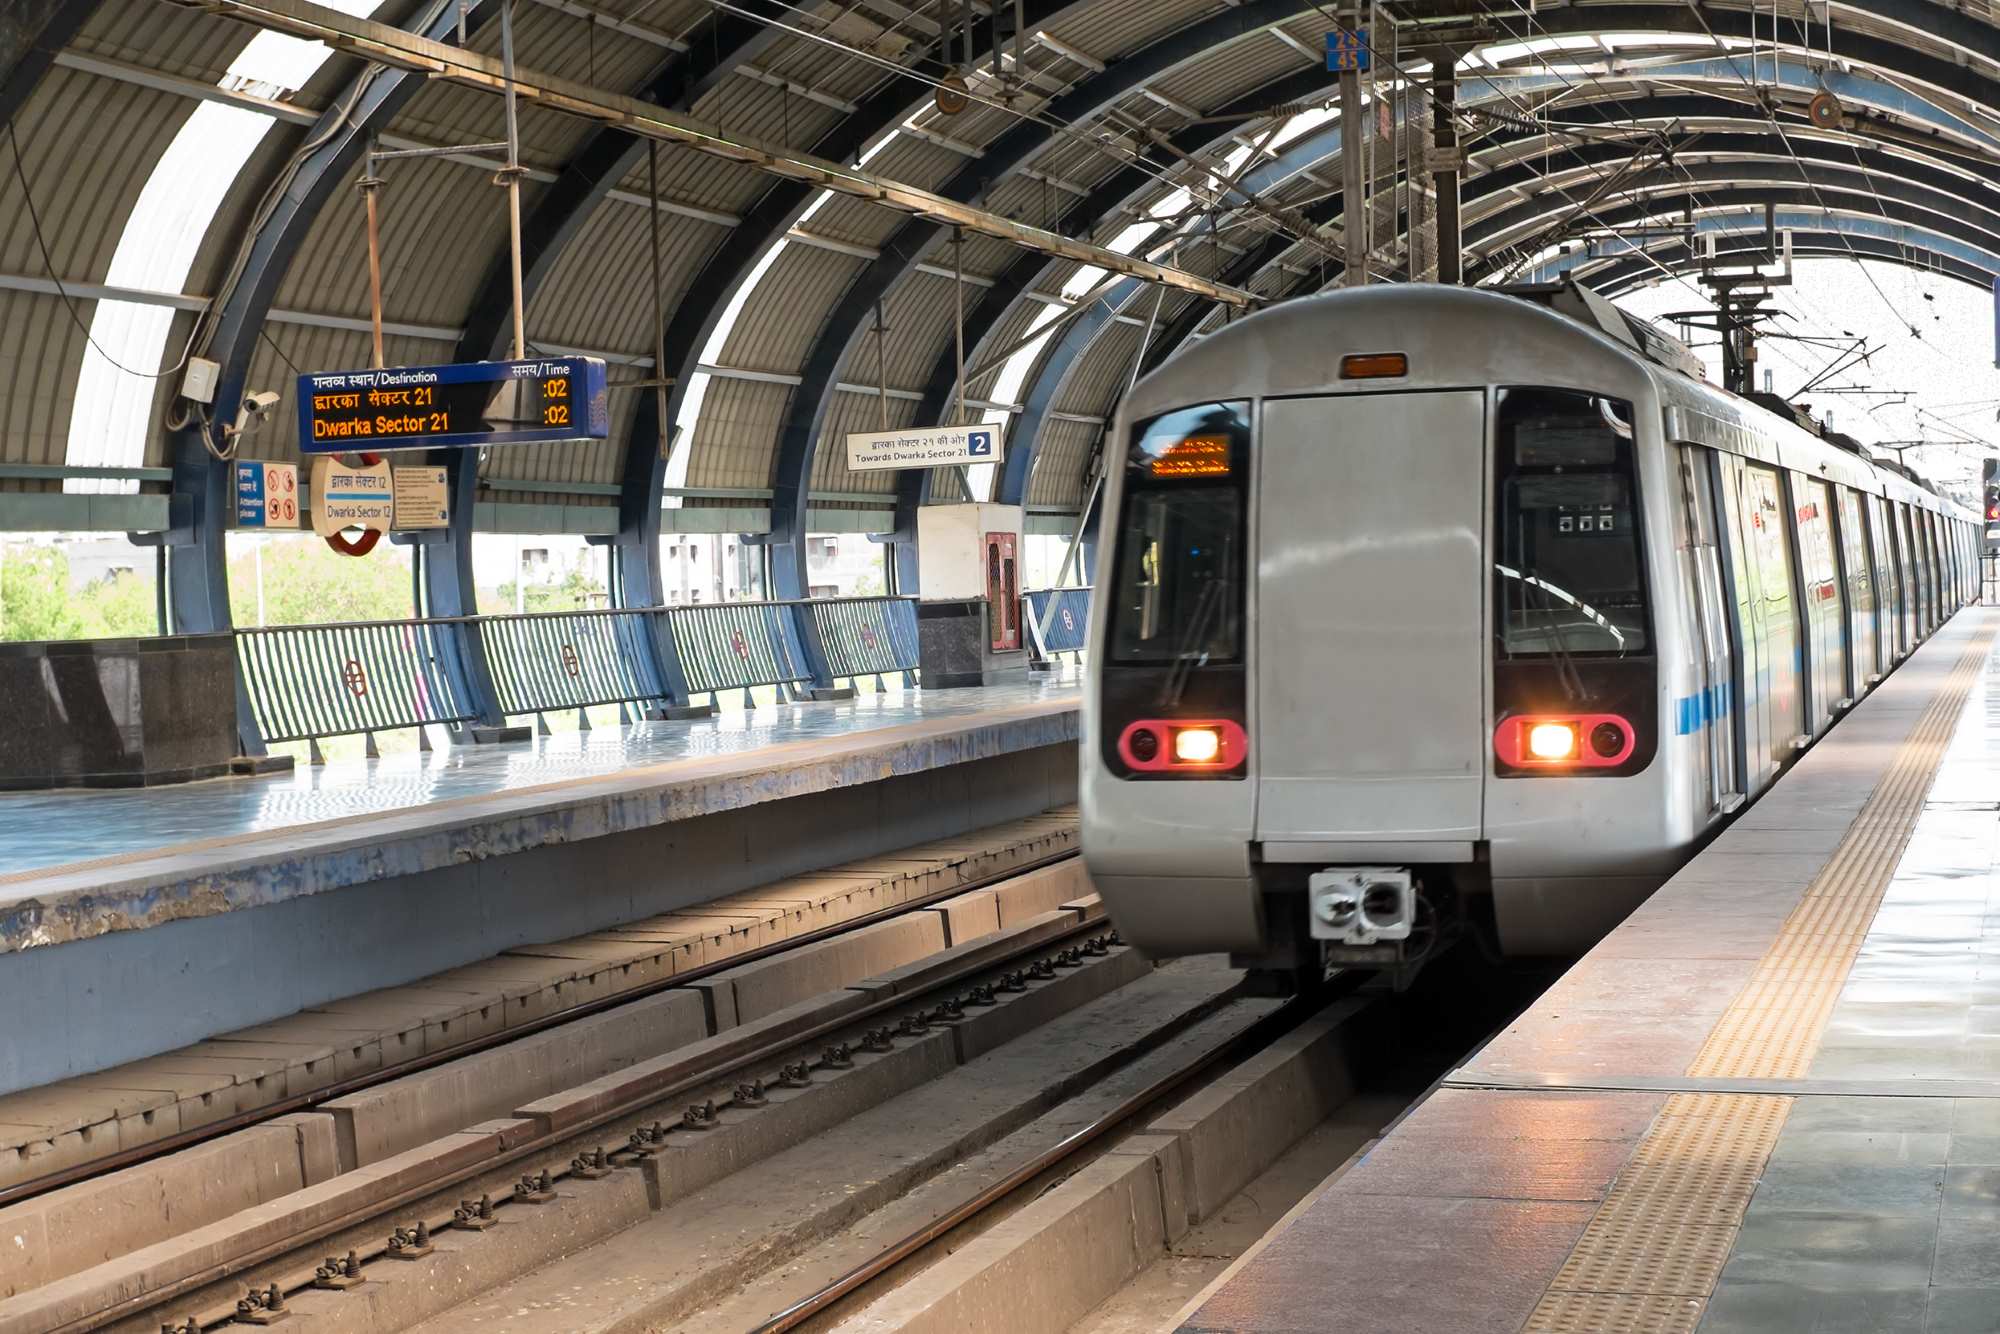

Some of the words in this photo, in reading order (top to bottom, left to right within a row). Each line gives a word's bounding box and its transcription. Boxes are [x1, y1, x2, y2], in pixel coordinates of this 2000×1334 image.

[312, 376, 345, 388] गन्तव्य
[314, 394, 360, 409] द्वारका
[368, 389, 410, 407] सेक्टर
[414, 388, 432, 406] 21
[314, 417, 371, 438] Dwarka
[376, 413, 424, 434] Sector
[430, 413, 448, 431] 21
[974, 435, 986, 452] 2
[855, 453, 891, 463] Towards
[894, 451, 926, 460] Dwarka
[928, 449, 955, 459] Sector
[957, 448, 967, 456] 21
[331, 474, 354, 489] द्वारका
[355, 472, 377, 488] सेक्टर
[378, 477, 387, 489] 12
[327, 505, 356, 518] Dwarka
[357, 505, 382, 518] Sector
[383, 505, 391, 518] 12
